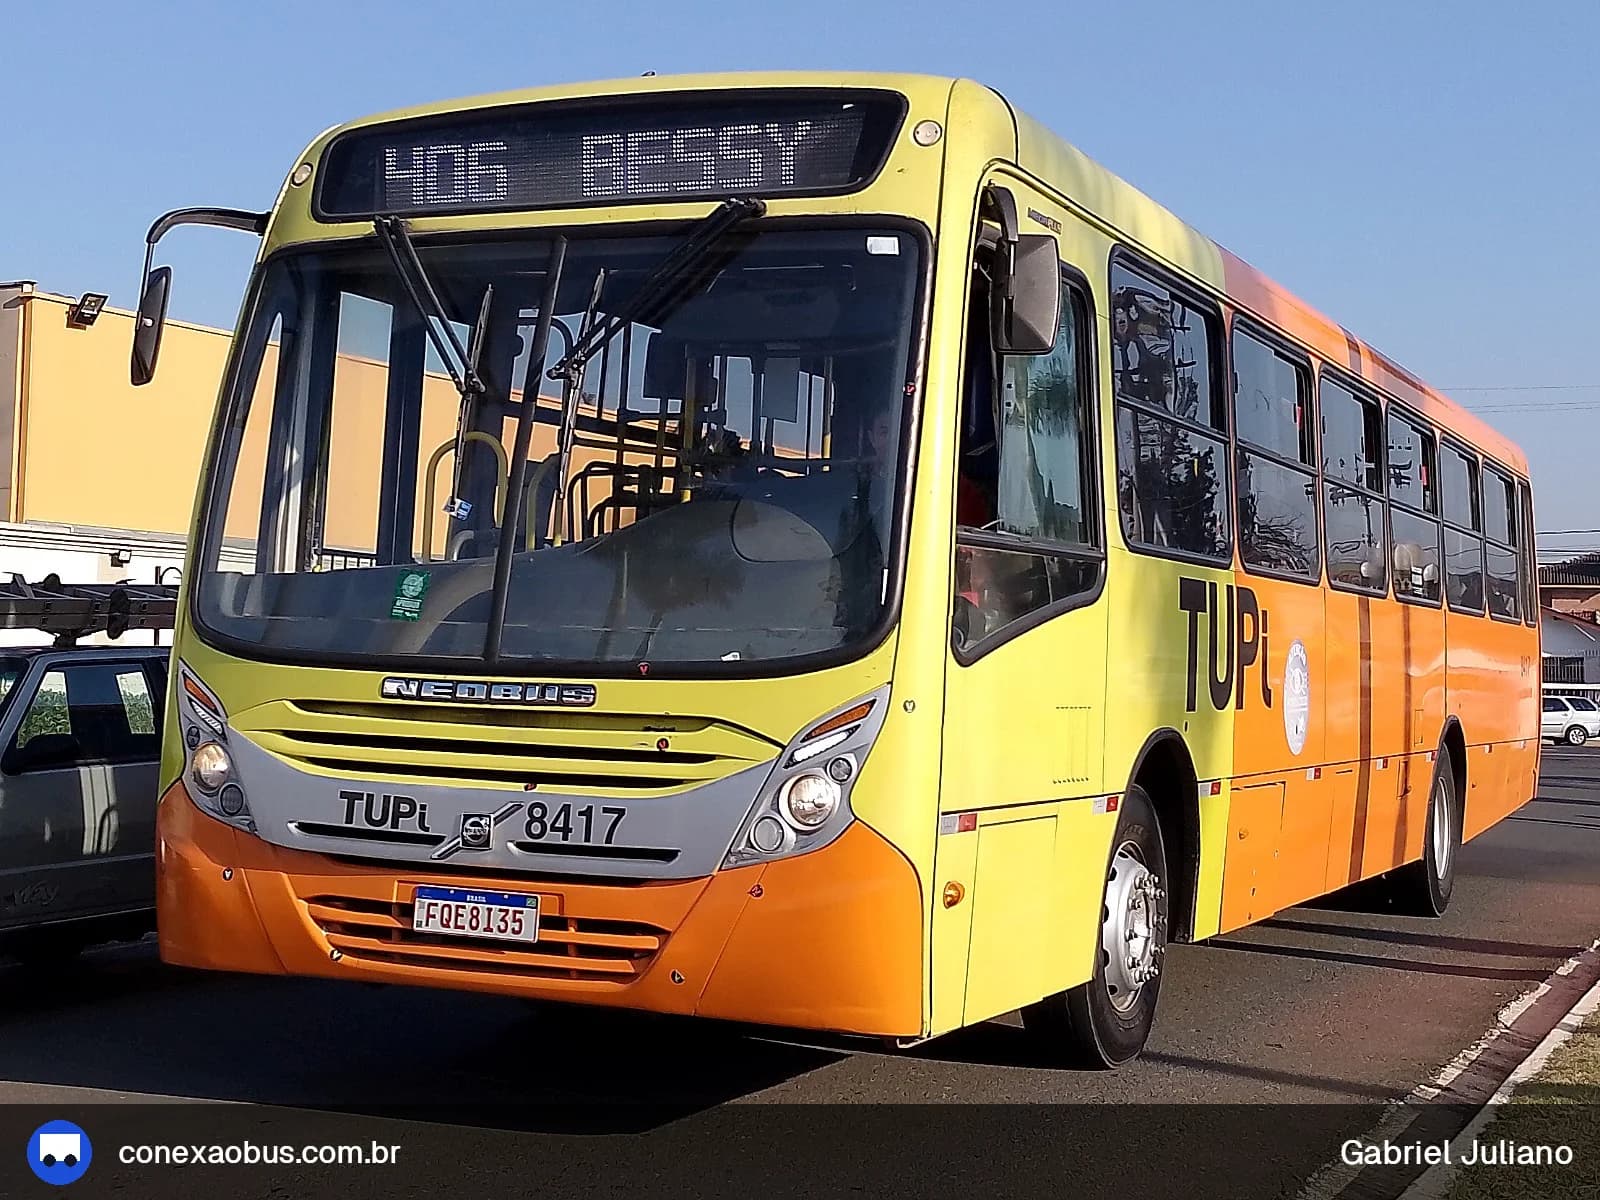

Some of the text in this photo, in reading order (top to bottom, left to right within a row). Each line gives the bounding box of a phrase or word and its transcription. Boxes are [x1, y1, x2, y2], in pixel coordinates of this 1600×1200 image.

[384, 120, 811, 205] 406 BESSY
[1180, 578, 1272, 712] TUPi
[382, 678, 595, 705] NEOBUS
[339, 790, 431, 833] TUPi
[524, 804, 626, 845] 8417
[425, 902, 525, 936] FQE8I35
